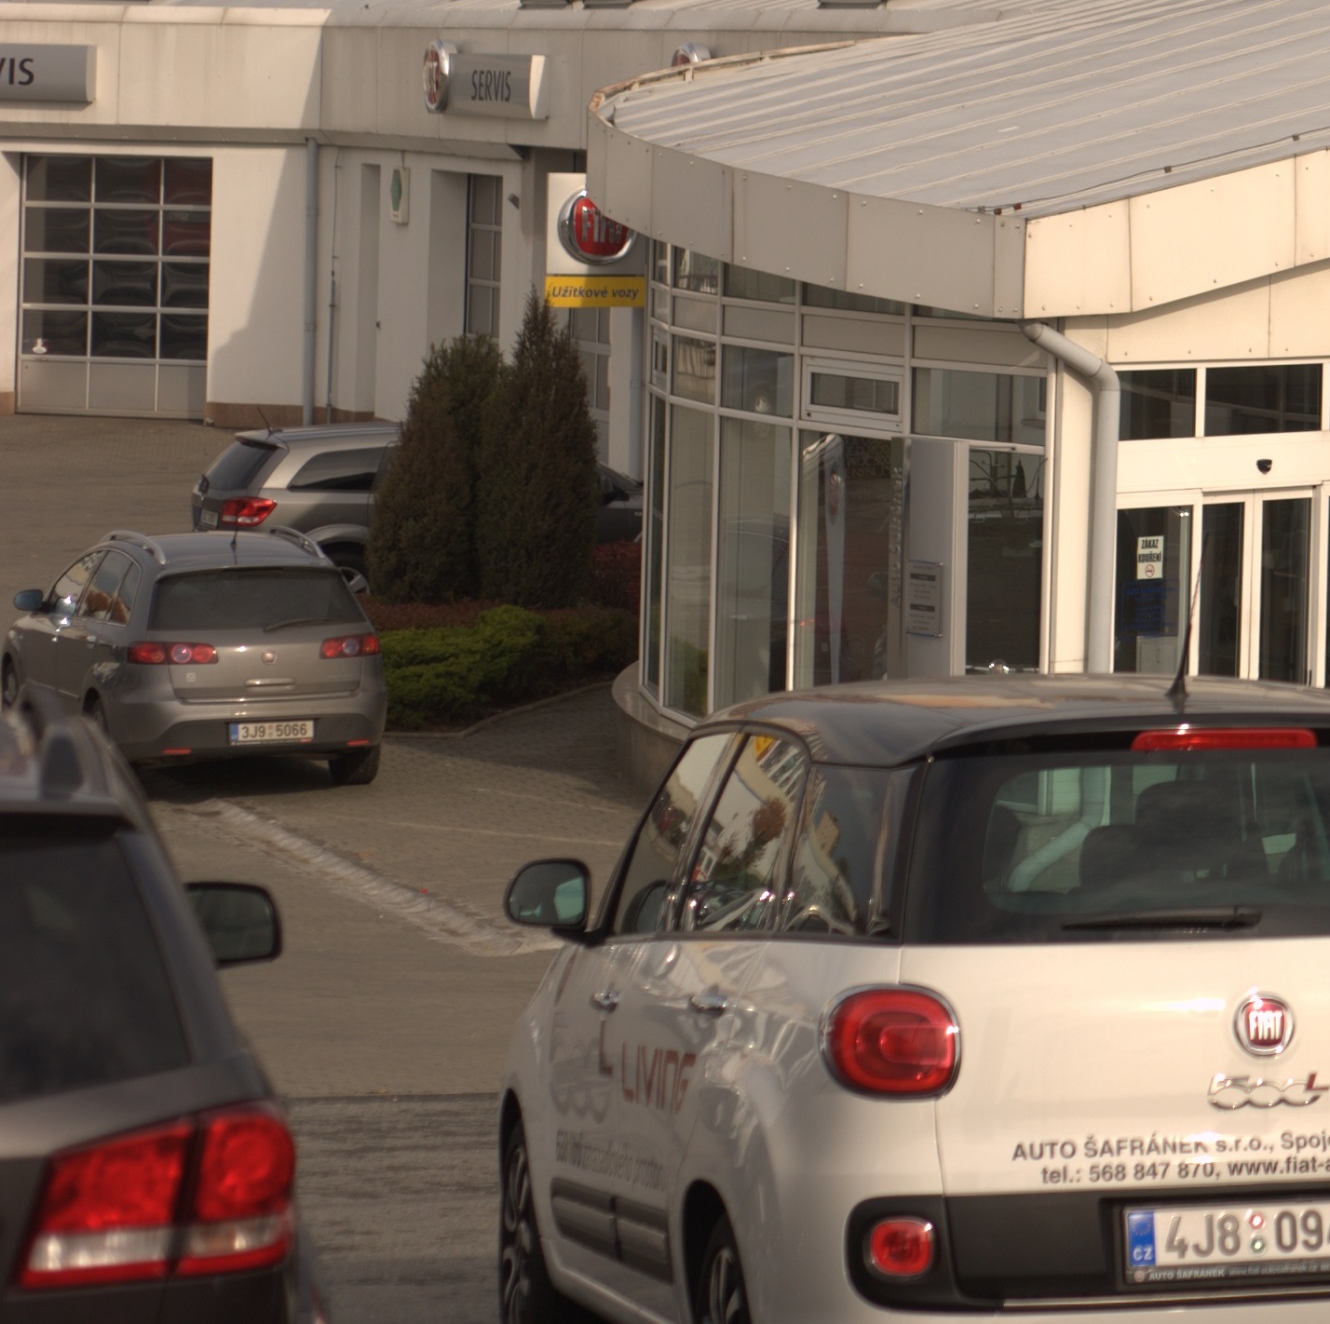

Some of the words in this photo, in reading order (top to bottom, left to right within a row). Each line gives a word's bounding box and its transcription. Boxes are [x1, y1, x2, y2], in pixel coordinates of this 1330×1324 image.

[471, 69, 511, 103] SERVIS
[552, 285, 609, 299] Užitkové
[611, 288, 639, 301] vozy
[241, 725, 266, 739] 3J9
[275, 723, 308, 738] 5066
[1249, 1010, 1284, 1041] FIAT
[622, 1041, 697, 1116] LIVING
[1012, 1141, 1077, 1162] AUTO
[1084, 1132, 1208, 1159] ŠAFRÁNEK
[1215, 1138, 1274, 1154] s.r.o.,
[1041, 1165, 1082, 1184] tel.:
[1089, 1163, 1127, 1184] 568
[1133, 1161, 1171, 1182] 847
[1177, 1161, 1221, 1181] 870,
[1133, 1247, 1153, 1261] CZ
[1165, 1213, 1241, 1259] 4J8
[1149, 1269, 1174, 1281] AUTO
